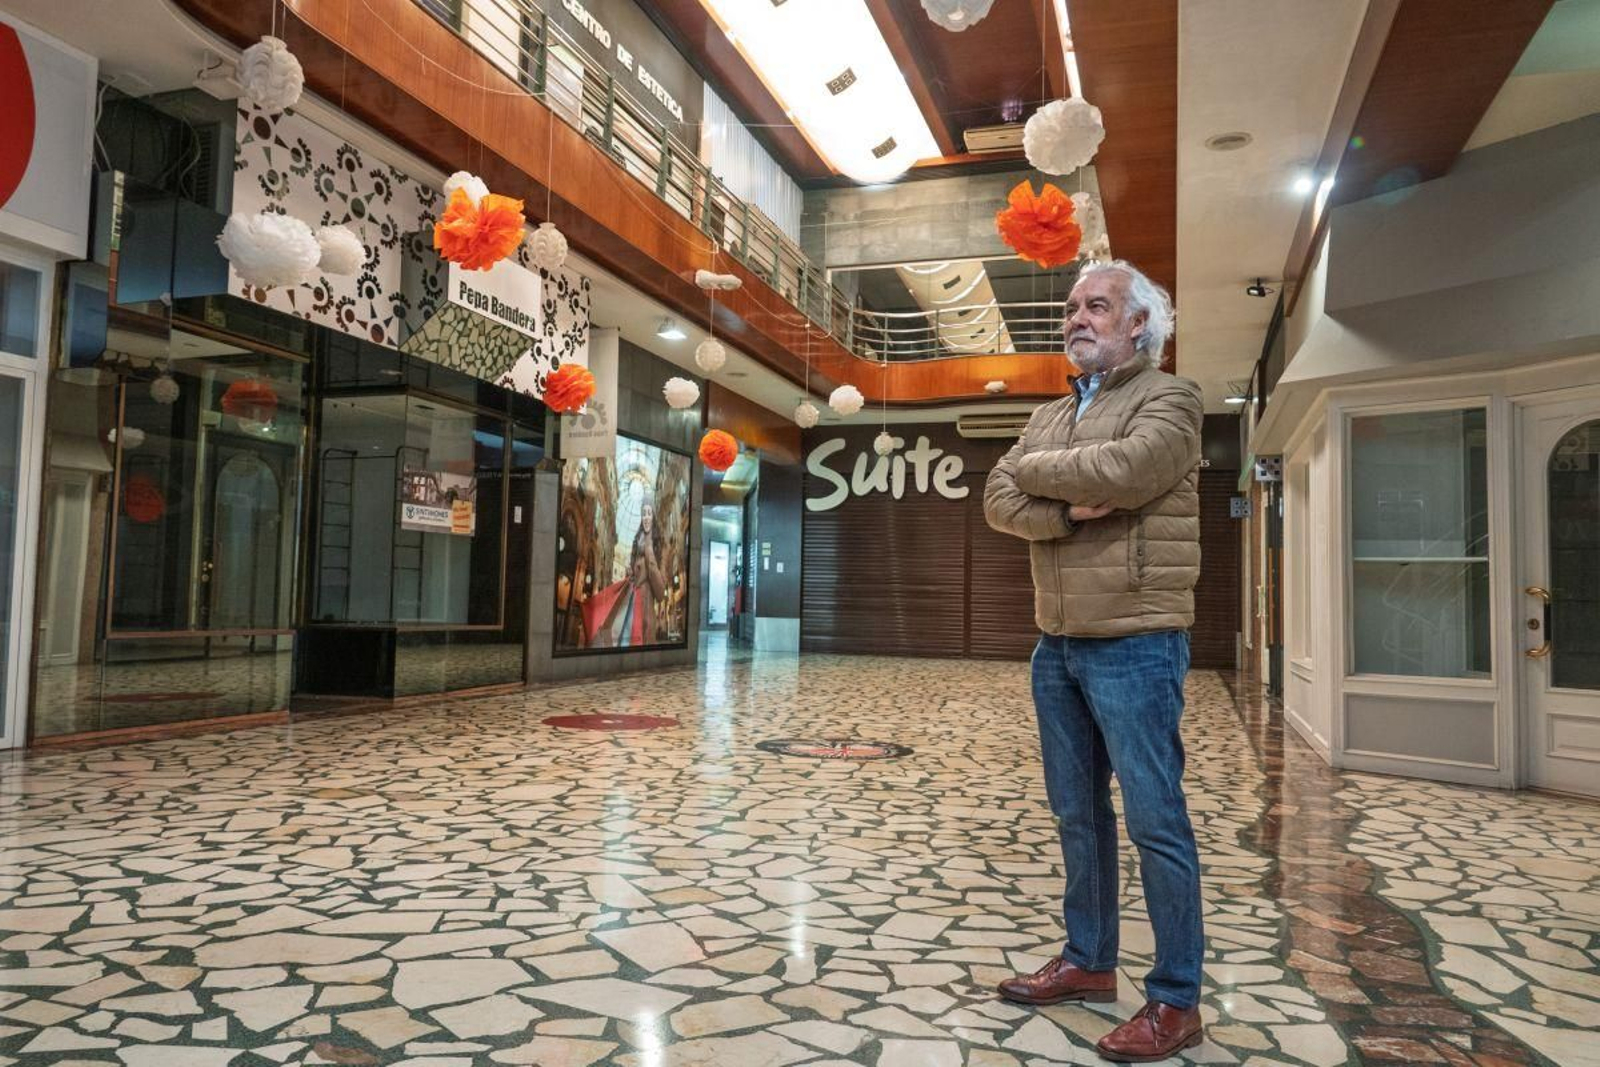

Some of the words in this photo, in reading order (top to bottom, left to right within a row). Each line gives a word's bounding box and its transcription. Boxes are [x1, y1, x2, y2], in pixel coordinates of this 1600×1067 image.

[616, 43, 634, 72] DE
[637, 64, 683, 122] ESTETICA
[459, 280, 489, 312] Pepa
[491, 295, 536, 333] Bandera
[805, 435, 970, 512] Suite
